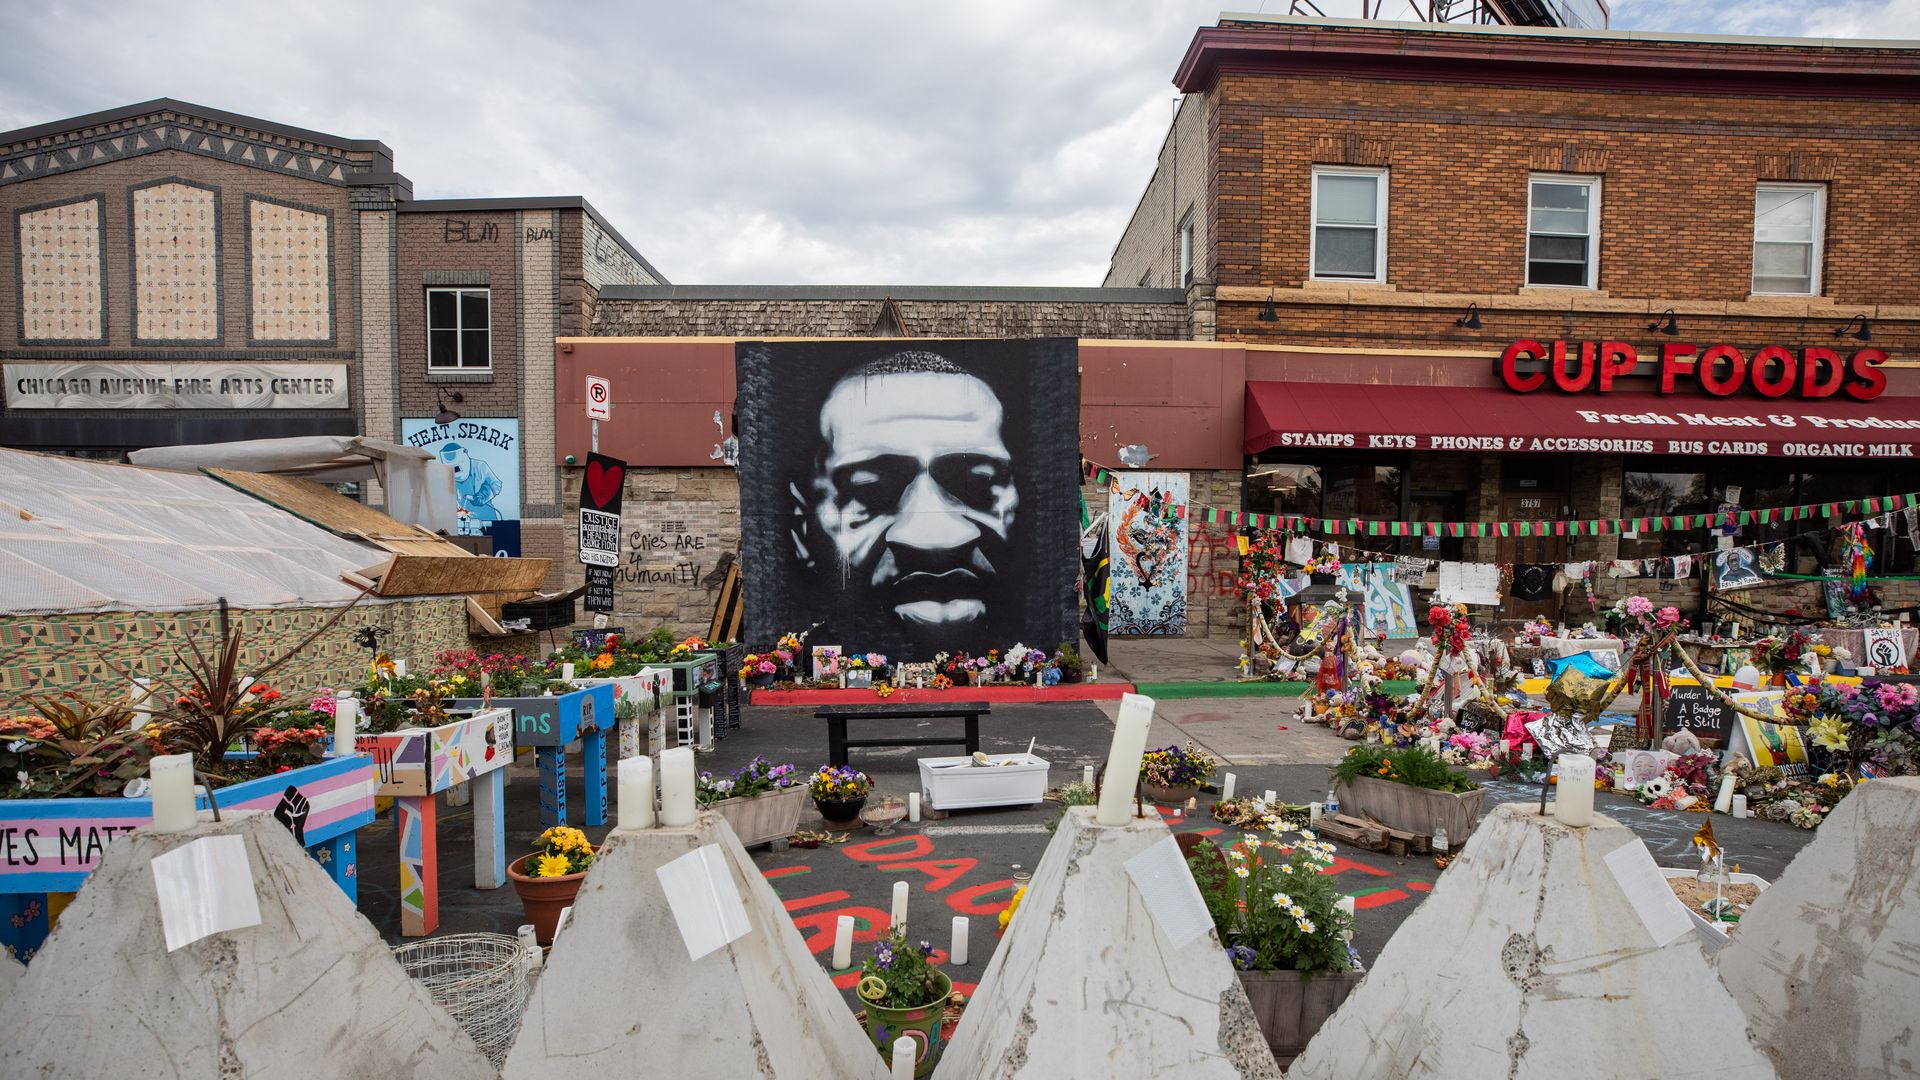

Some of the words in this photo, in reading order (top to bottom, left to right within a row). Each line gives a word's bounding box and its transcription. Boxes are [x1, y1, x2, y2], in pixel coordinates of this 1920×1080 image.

[445, 218, 499, 243] BLM
[525, 227, 553, 243] BLM
[1501, 339, 1638, 393] CUP
[1659, 343, 1889, 400] FOODS
[17, 378, 91, 395] CHICAGO
[100, 378, 167, 395] AVENUE
[174, 378, 212, 395] FINE
[220, 378, 263, 395] ARTS
[270, 378, 335, 395] CENTER
[1576, 410, 1679, 425] Fresh
[1676, 413, 1767, 427] Meat
[1767, 414, 1797, 427] &
[408, 424, 456, 448] HEAT,
[457, 422, 514, 450] SPARK
[1281, 432, 1355, 447] STAMPS
[1368, 434, 1417, 448] KEYS
[1430, 435, 1504, 450] PHONES
[1508, 437, 1524, 449] &
[1529, 437, 1654, 453] ACCESSORIES
[1668, 440, 1703, 454] BUS
[1707, 441, 1768, 455] CARDS
[1782, 443, 1864, 457] ORGANIC
[1868, 444, 1914, 457] MILK
[584, 513, 617, 528] JUSTICE
[675, 534, 705, 550] ARE
[1887, 630, 1900, 638] HIS
[1670, 688, 1701, 700] Murder
[583, 703, 592, 716] RIP
[1679, 703, 1687, 714] A
[1692, 703, 1721, 718] Badge
[1676, 716, 1691, 728] Is
[1694, 716, 1720, 729] Still
[600, 796, 608, 820] NO
